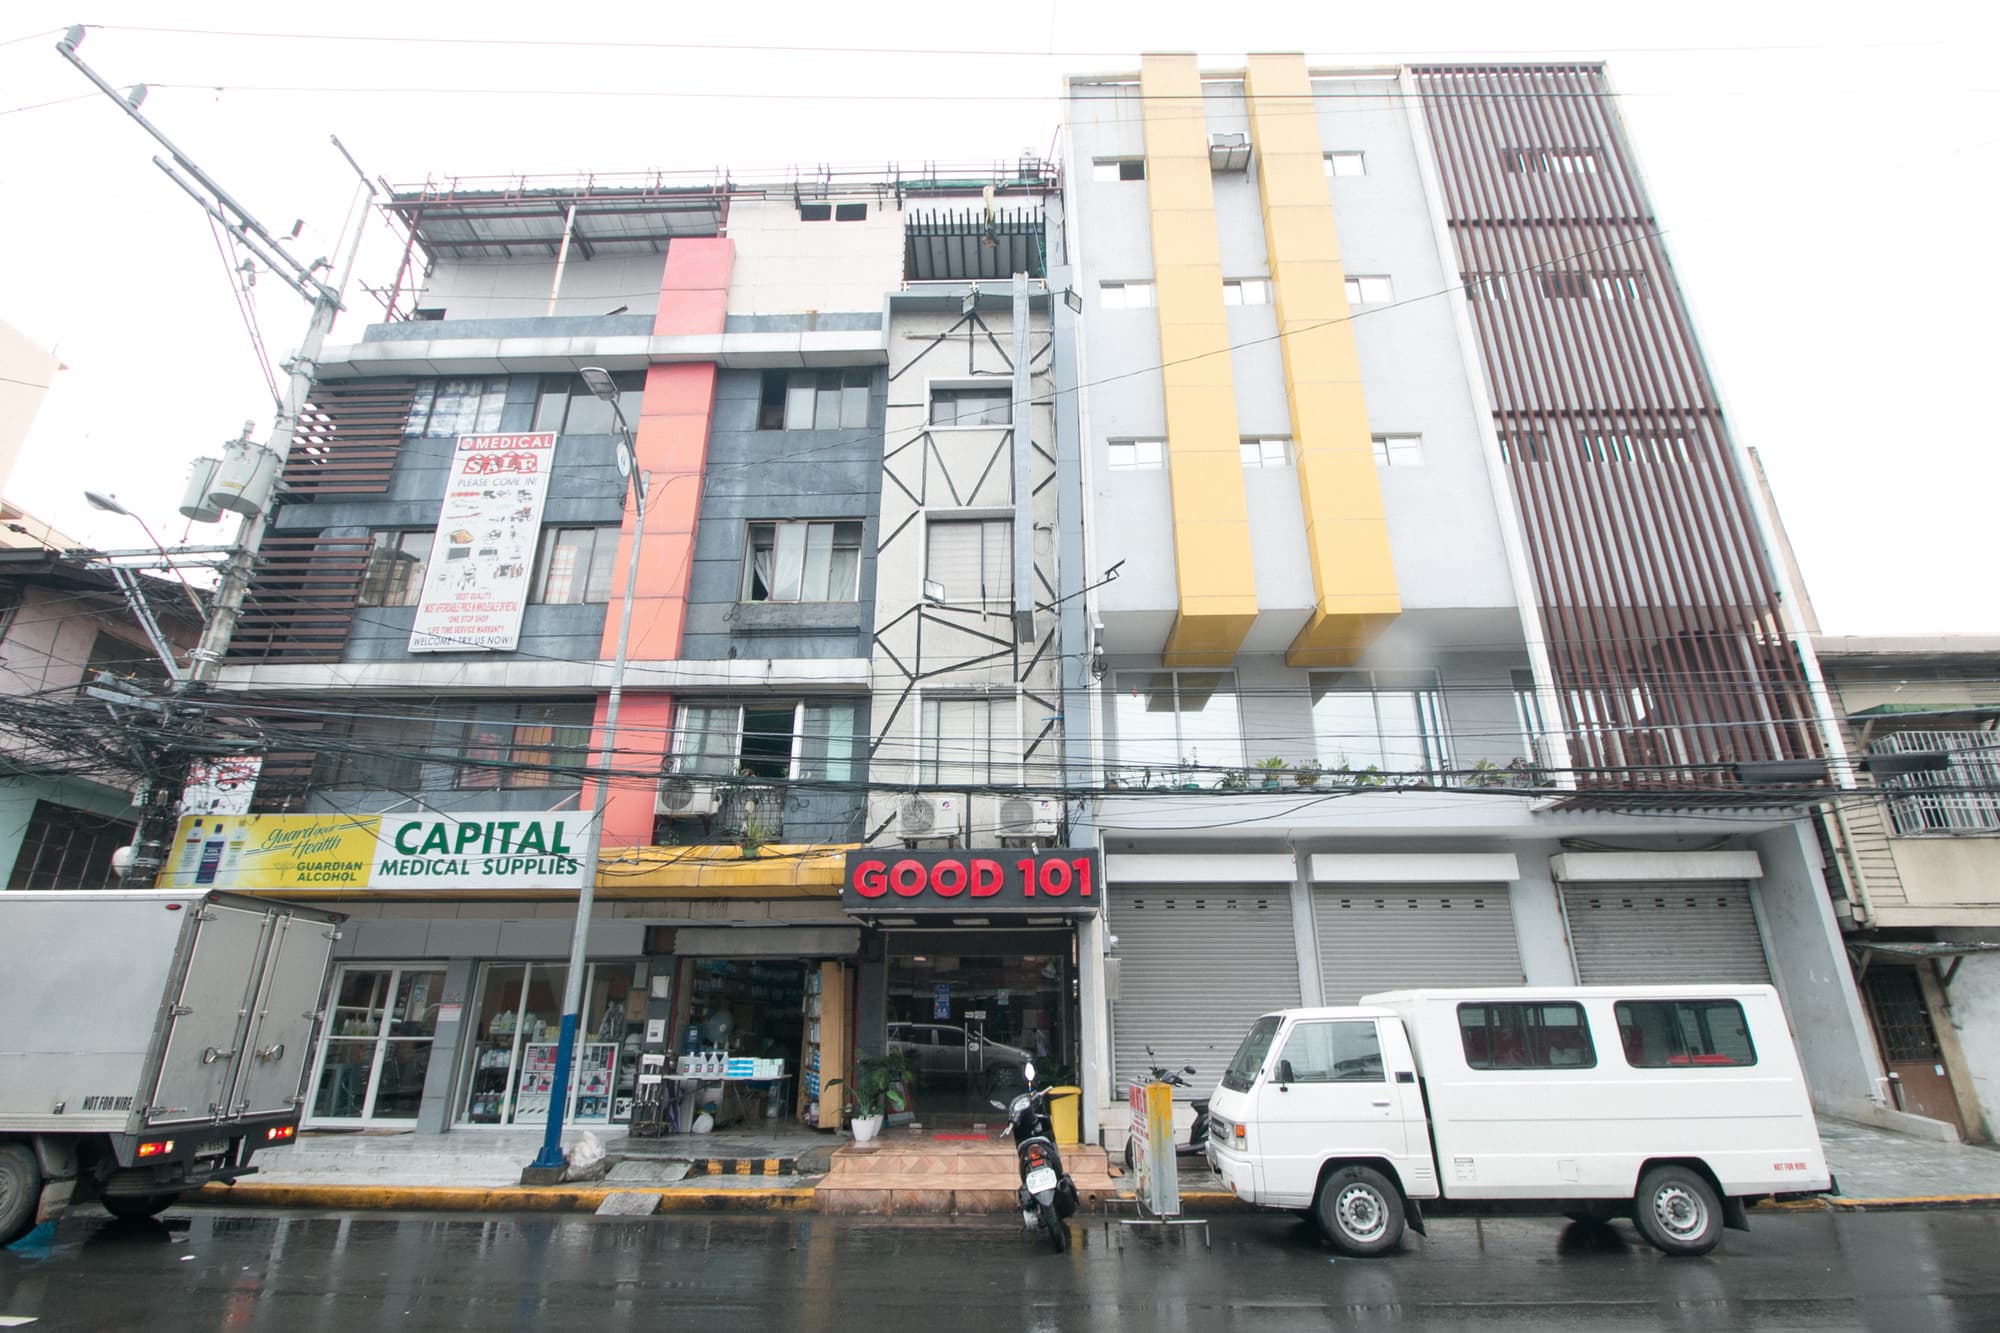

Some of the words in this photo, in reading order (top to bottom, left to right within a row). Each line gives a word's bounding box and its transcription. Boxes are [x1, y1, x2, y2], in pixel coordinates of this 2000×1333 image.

[475, 436, 552, 449] MEDICAL
[464, 456, 537, 474] SALE
[458, 479, 488, 487] PLEASE
[493, 478, 520, 486] COME
[461, 615, 474, 623] STOP
[476, 625, 504, 633] WARRANTY
[474, 636, 485, 644] US
[487, 635, 513, 645] NOW!
[395, 821, 571, 855] CAPITAL
[291, 835, 341, 859] Health
[297, 862, 363, 871] GUARDIAN
[379, 859, 470, 876] MEDICAL
[482, 858, 578, 875] SUPPLIES
[296, 872, 357, 882] ALCOHOL
[852, 859, 1004, 898] GOOD
[1017, 858, 1092, 897] 101
[82, 1096, 99, 1111] NOT
[98, 1096, 114, 1111] FOR
[114, 1096, 133, 1111] HIRE
